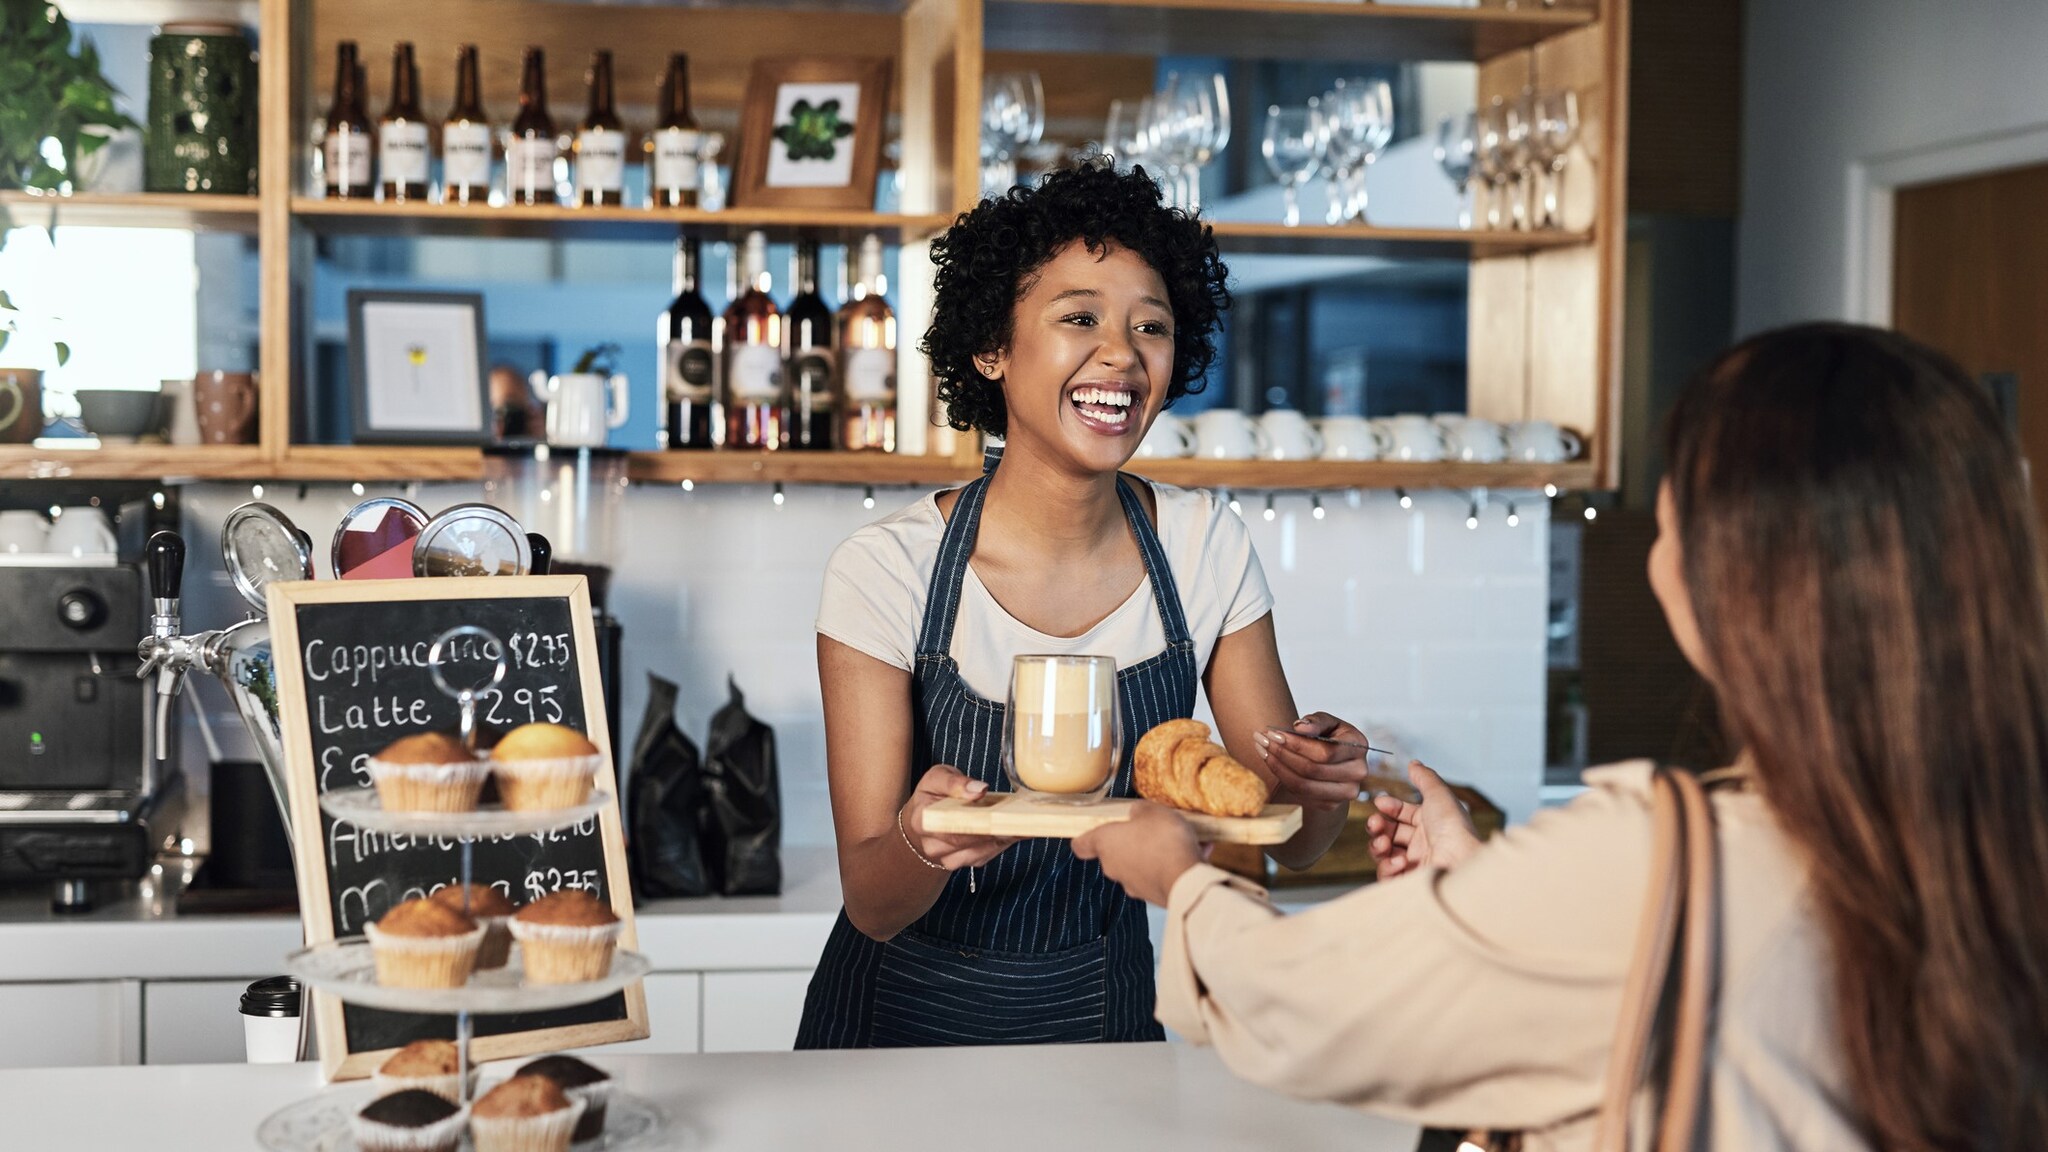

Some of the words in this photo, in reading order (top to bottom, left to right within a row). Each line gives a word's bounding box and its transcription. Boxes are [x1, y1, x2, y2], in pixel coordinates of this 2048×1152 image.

[305, 637, 503, 687] Cappucino
[509, 632, 570, 669] $2.75
[318, 694, 432, 734] Latte
[329, 817, 515, 867] Americ
[339, 876, 520, 932] Moca
